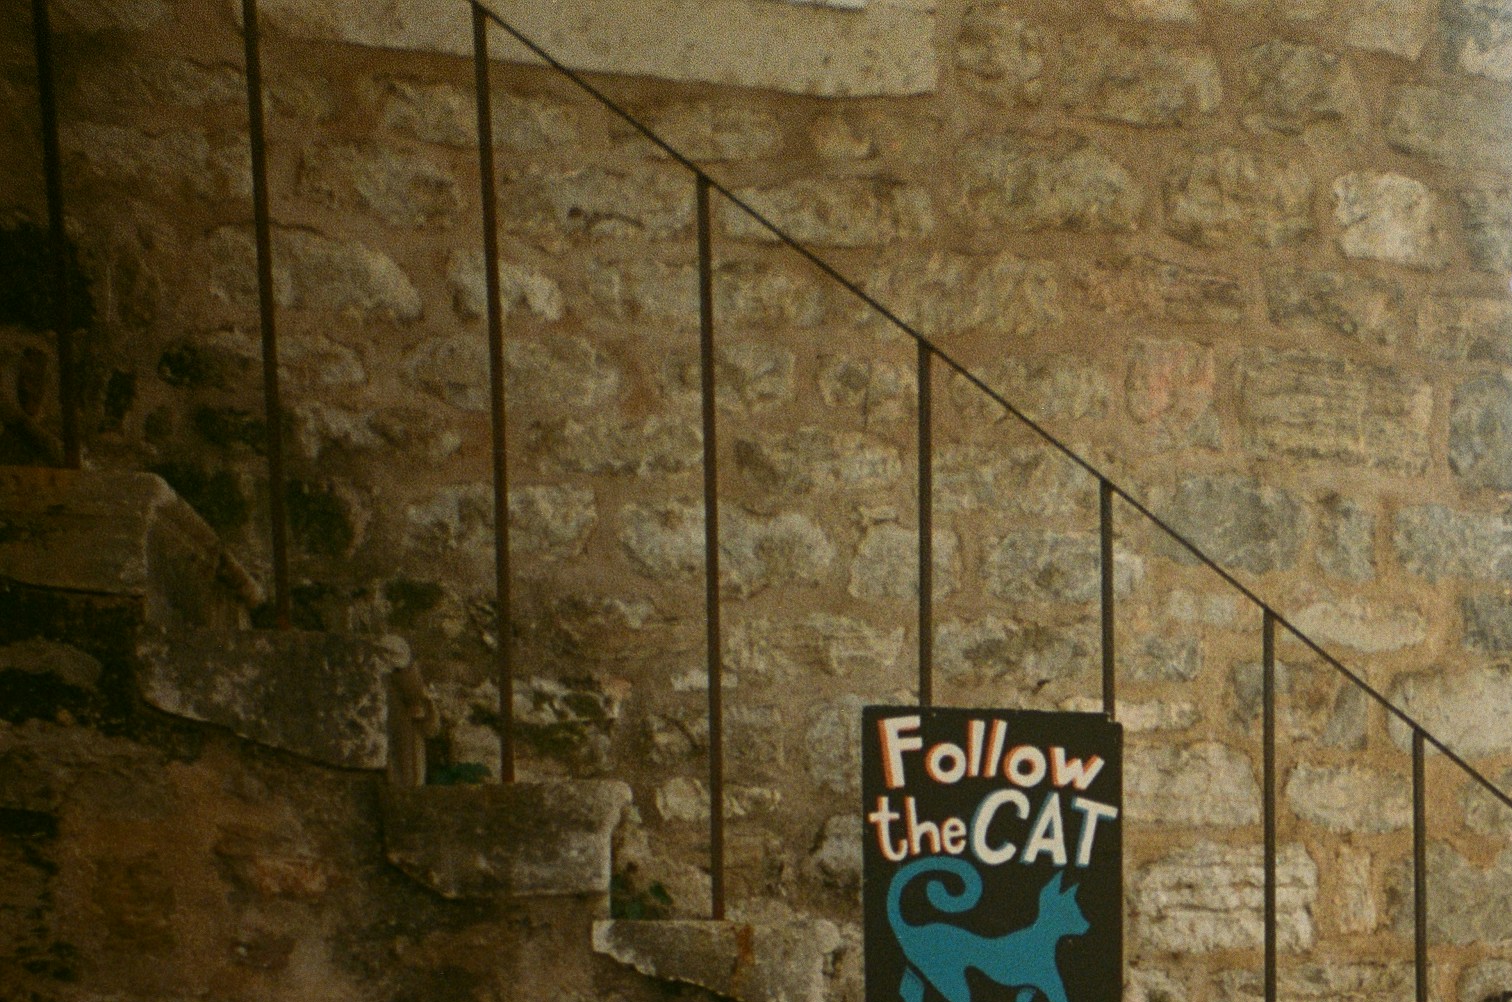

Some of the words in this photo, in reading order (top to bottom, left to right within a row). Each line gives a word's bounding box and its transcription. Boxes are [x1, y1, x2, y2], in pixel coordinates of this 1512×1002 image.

[877, 715, 1105, 790] Follow
[868, 796, 967, 861] the
[970, 788, 1118, 868] CAT
